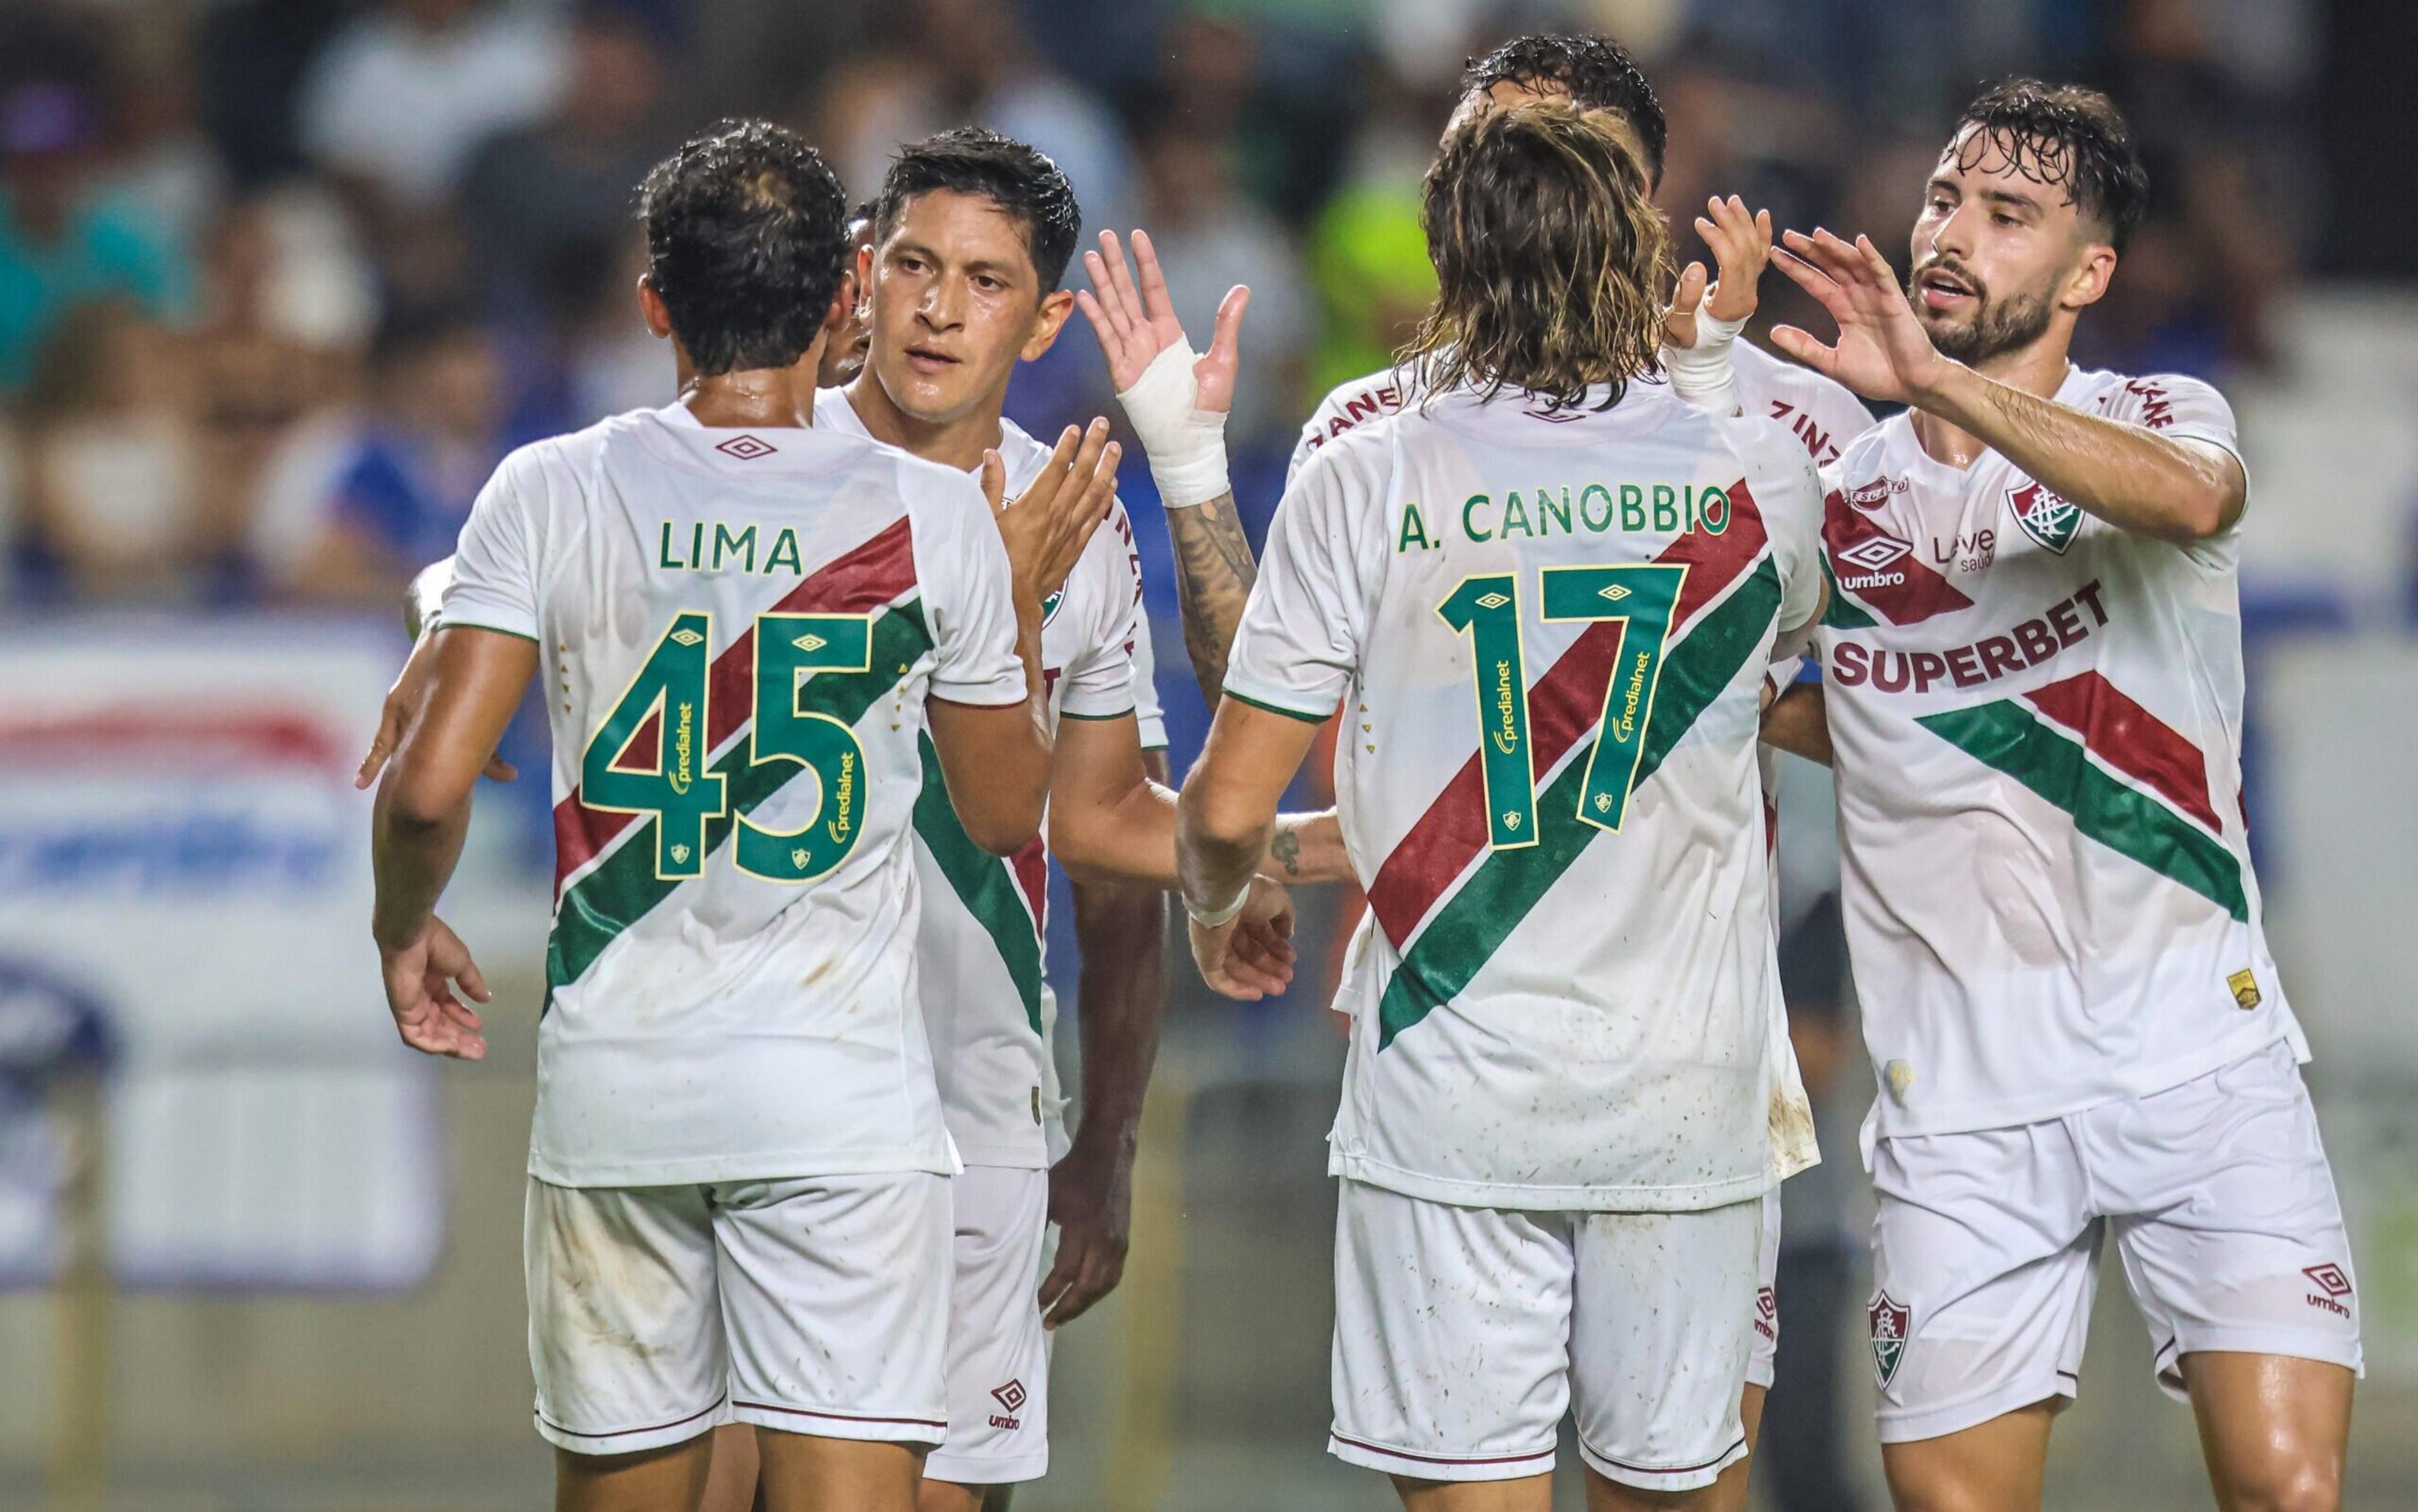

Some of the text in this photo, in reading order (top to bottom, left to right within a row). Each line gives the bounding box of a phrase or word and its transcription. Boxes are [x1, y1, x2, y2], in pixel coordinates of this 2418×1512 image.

[659, 520, 803, 577] LIMA
[1397, 483, 1732, 553] A. CANOBBIO
[1844, 571, 1905, 589] umbro
[1831, 577, 2109, 694] SUPERBET
[1433, 562, 1691, 851] 17
[1496, 659, 1518, 741] predialnet
[1621, 651, 1650, 732] predialnet
[581, 611, 873, 883] 45
[676, 702, 693, 783] predialnet
[836, 751, 854, 831] predialnet
[2307, 1293, 2351, 1319] umbro
[989, 1414, 1020, 1430] umbo
